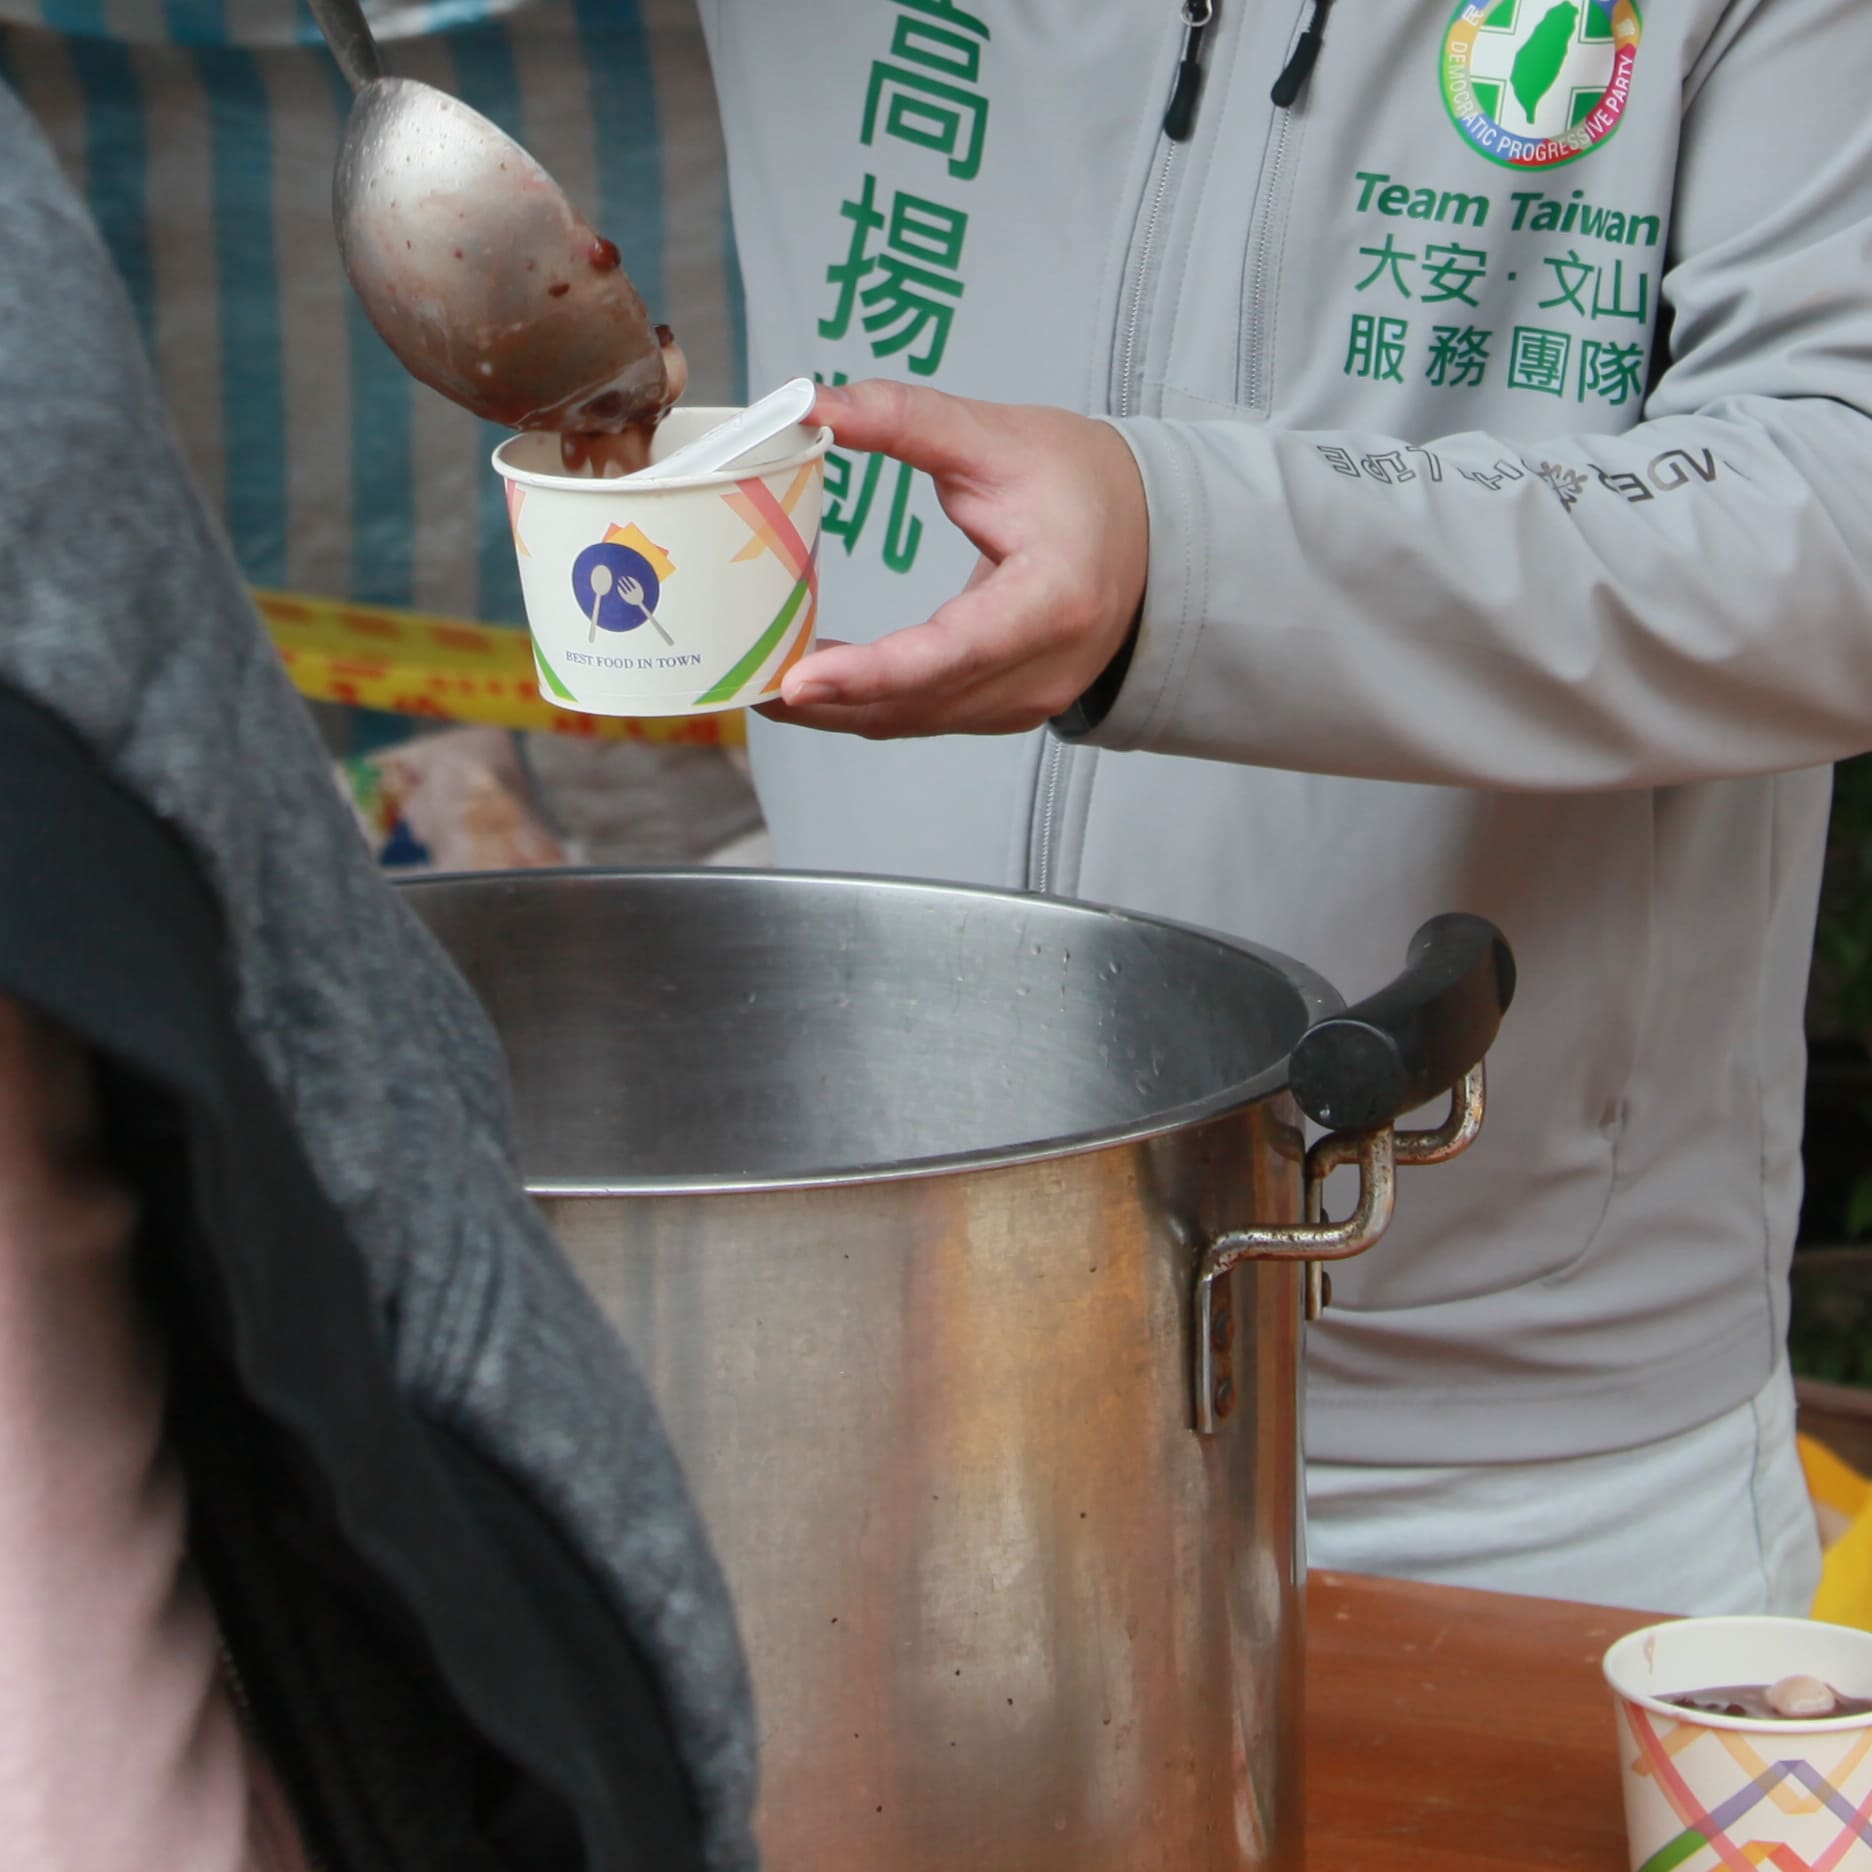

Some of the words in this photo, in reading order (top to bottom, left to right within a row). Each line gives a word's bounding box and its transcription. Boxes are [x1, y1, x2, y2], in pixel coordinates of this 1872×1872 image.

[1448, 41, 1493, 147] DEMOCRATIC
[1497, 109, 1614, 162] PROGRESSIVE
[1605, 55, 1633, 115] PARTY
[1354, 171, 1490, 227] Team
[1508, 190, 1660, 246] Taiwan
[1344, 313, 1645, 406] 服務團隊
[566, 650, 593, 666] BEST
[596, 656, 633, 669] FOOD
[637, 658, 653, 669] IN
[655, 654, 701, 668] TOWN
